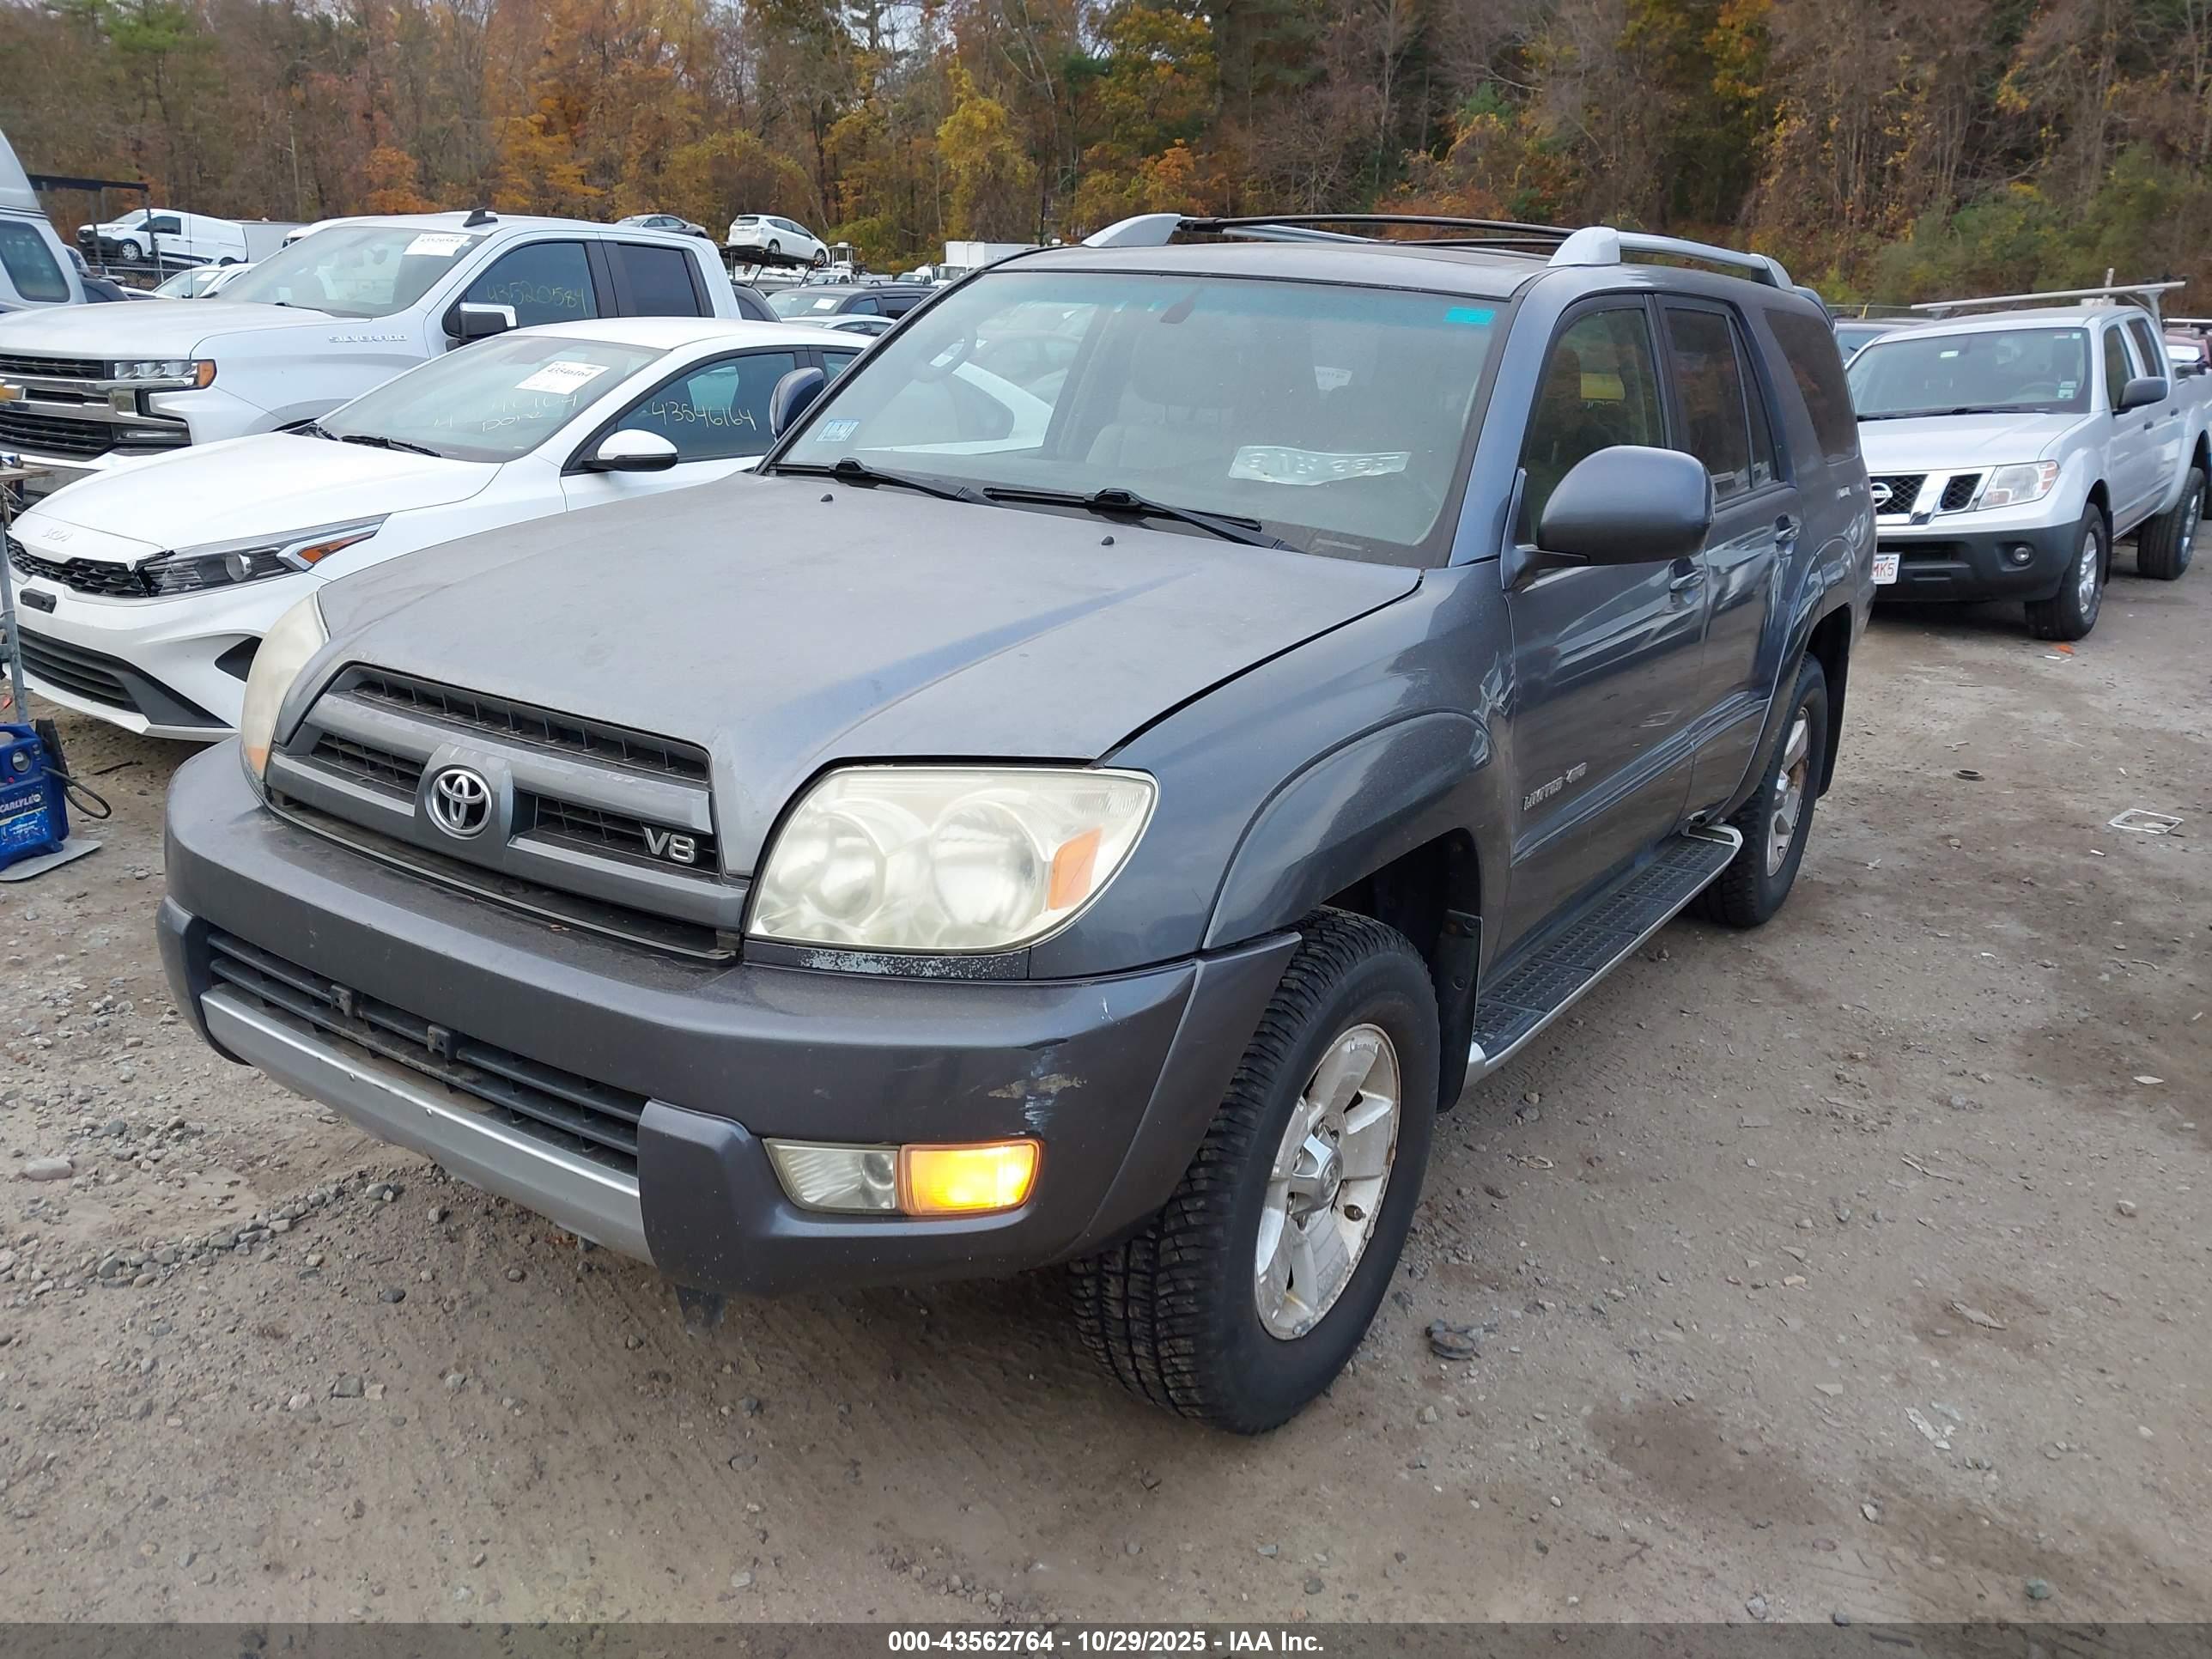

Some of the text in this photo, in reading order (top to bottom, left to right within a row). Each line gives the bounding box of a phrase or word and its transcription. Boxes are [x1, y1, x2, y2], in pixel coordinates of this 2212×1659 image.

[329, 334, 408, 343] SILVERADO
[652, 400, 757, 431] 43546164
[1522, 776, 1564, 811] LIMITED
[642, 826, 696, 864] V8
